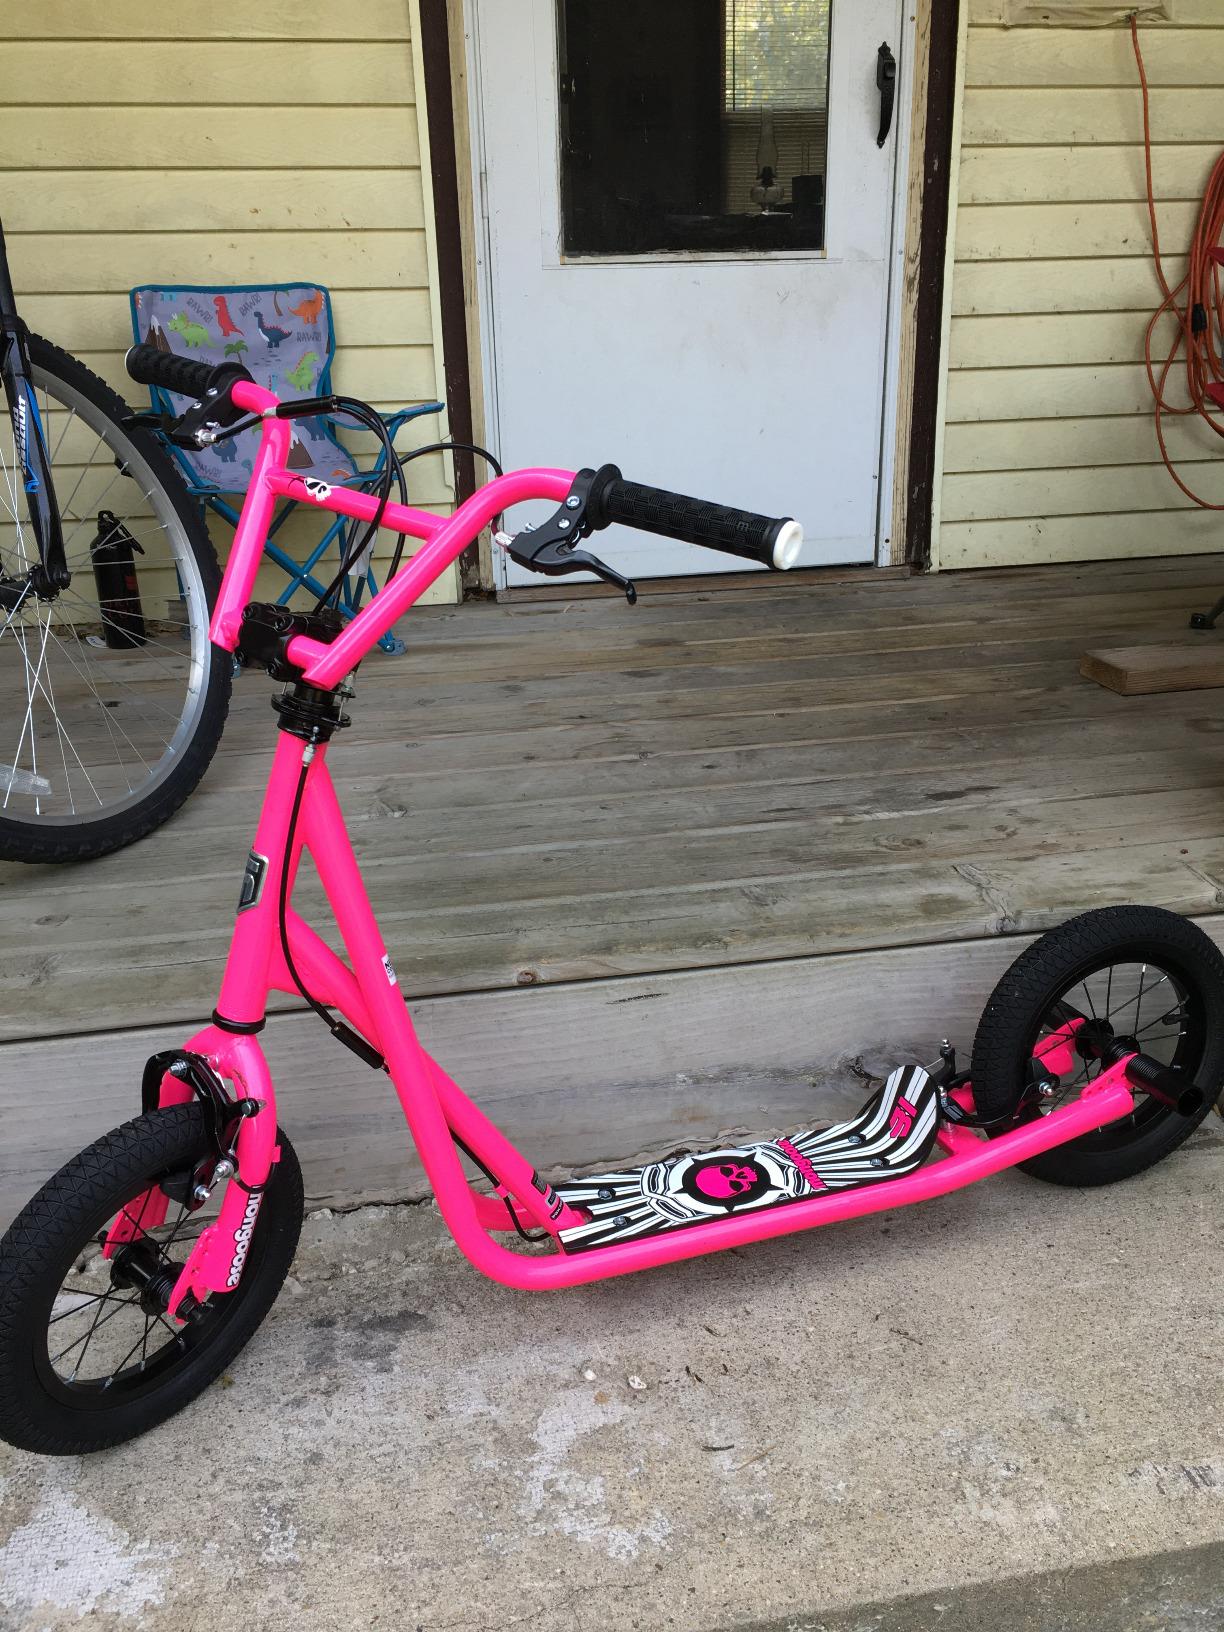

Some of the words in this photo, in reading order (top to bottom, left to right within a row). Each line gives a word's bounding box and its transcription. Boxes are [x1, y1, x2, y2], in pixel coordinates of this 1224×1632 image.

[186, 297, 214, 323] RAWR!
[296, 330, 322, 343] RAWR!
[775, 1138, 829, 1190] mongoose
[226, 1184, 265, 1288] mongoose
